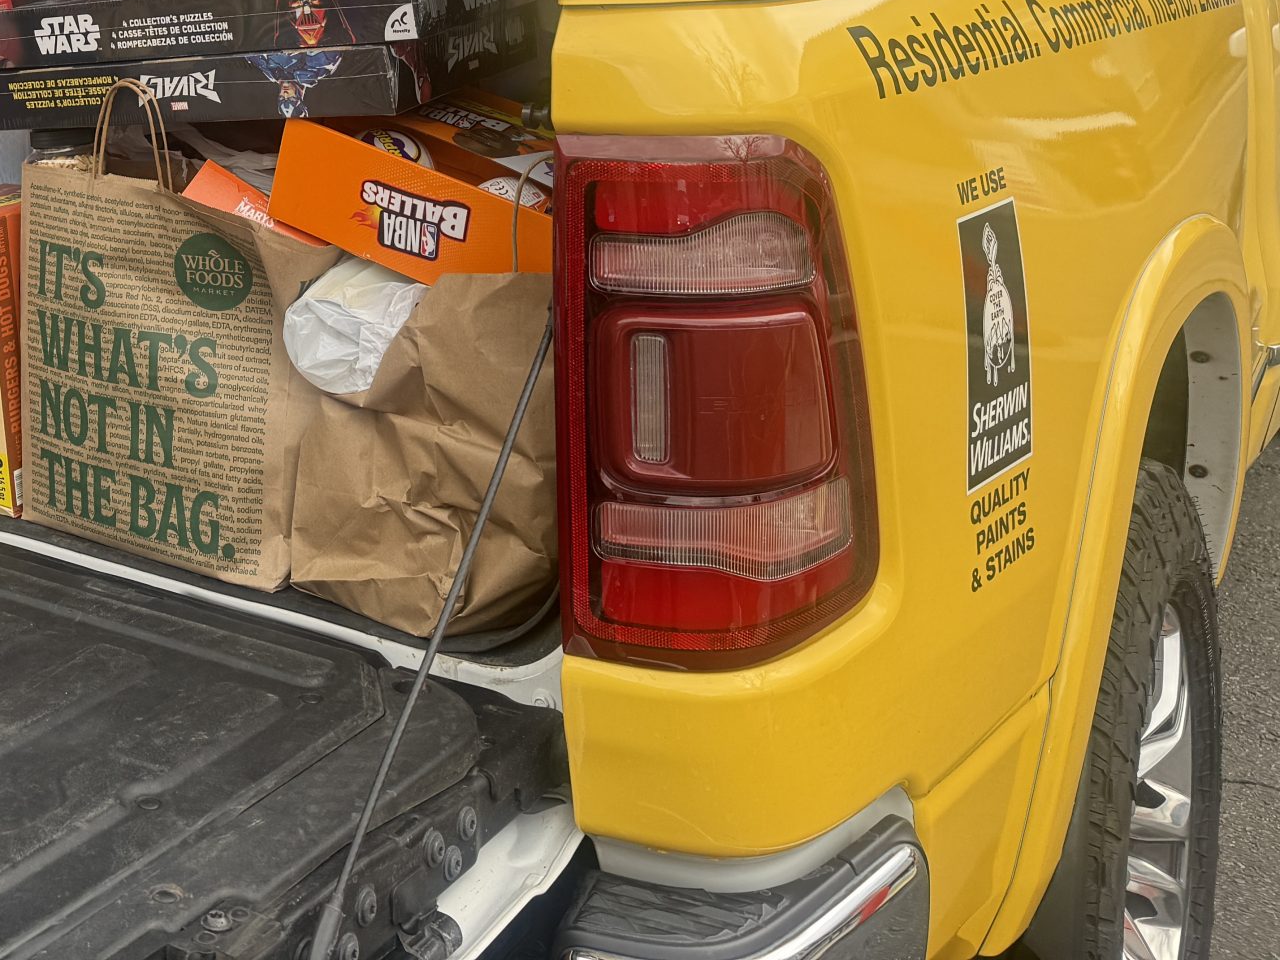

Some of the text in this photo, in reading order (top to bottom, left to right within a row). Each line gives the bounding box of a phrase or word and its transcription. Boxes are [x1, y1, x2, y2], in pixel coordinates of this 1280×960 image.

[34, 13, 100, 37] STAR
[129, 15, 178, 28] COLLECTOR'S
[180, 11, 214, 23] PUZZLES
[112, 21, 229, 39] 4 CASSE-TÊTES DE COLLECTION
[36, 31, 101, 56] WARS
[110, 31, 234, 49] 4 ROMPECABEZAS DE COLECCIÓN
[847, 0, 1042, 100] Residential.
[8, 80, 45, 92] COLECCIÓN
[47, 78, 57, 87] DE
[59, 75, 112, 87] ROMPECABEZAS
[12, 89, 51, 100] COLLECTION
[51, 89, 63, 98] DE
[26, 96, 102, 109] COLLECTOR'S PUZZLES
[956, 167, 1007, 205] WE USE
[362, 181, 469, 241] BALLERS
[383, 212, 420, 255] NBA
[181, 252, 245, 274] WHOLE
[37, 239, 106, 309] IT'S
[185, 270, 244, 289] FOODS
[125, 292, 139, 301] Red
[193, 287, 235, 296] MARKET
[990, 290, 1003, 302] COVER
[992, 300, 1002, 309] THE
[0, 307, 15, 337] HOT
[162, 306, 191, 318] disodium
[193, 311, 220, 321] calcium,
[221, 313, 242, 323] EDTA,
[991, 309, 1005, 321] EARTH
[161, 316, 187, 327] dodecyl
[212, 322, 233, 331] EDTA,
[4, 341, 16, 352] &
[37, 309, 219, 398] WHAT'S
[182, 398, 267, 415] microparticularized whey
[224, 393, 268, 404] mechanically
[177, 408, 266, 425] monopotassium glutamate,
[971, 382, 1028, 438] SHERWIN
[39, 378, 176, 471] NOT IN
[187, 417, 238, 431] Nature identical
[204, 430, 249, 443] hydrogenated
[173, 445, 203, 457] potassium
[205, 451, 231, 462] sorbate,
[197, 440, 229, 451] potassium
[229, 466, 264, 477] propylene
[204, 480, 263, 495] saccharin sodium
[243, 476, 264, 486] acids,
[39, 447, 118, 528] THE
[129, 474, 236, 560] BAG.
[232, 495, 263, 506] synthetic
[970, 468, 1030, 525] QUALITY
[236, 505, 263, 515] sodium
[976, 501, 1027, 556] PAINTS
[235, 546, 261, 556] acetate
[971, 527, 1035, 593] & STAINS
